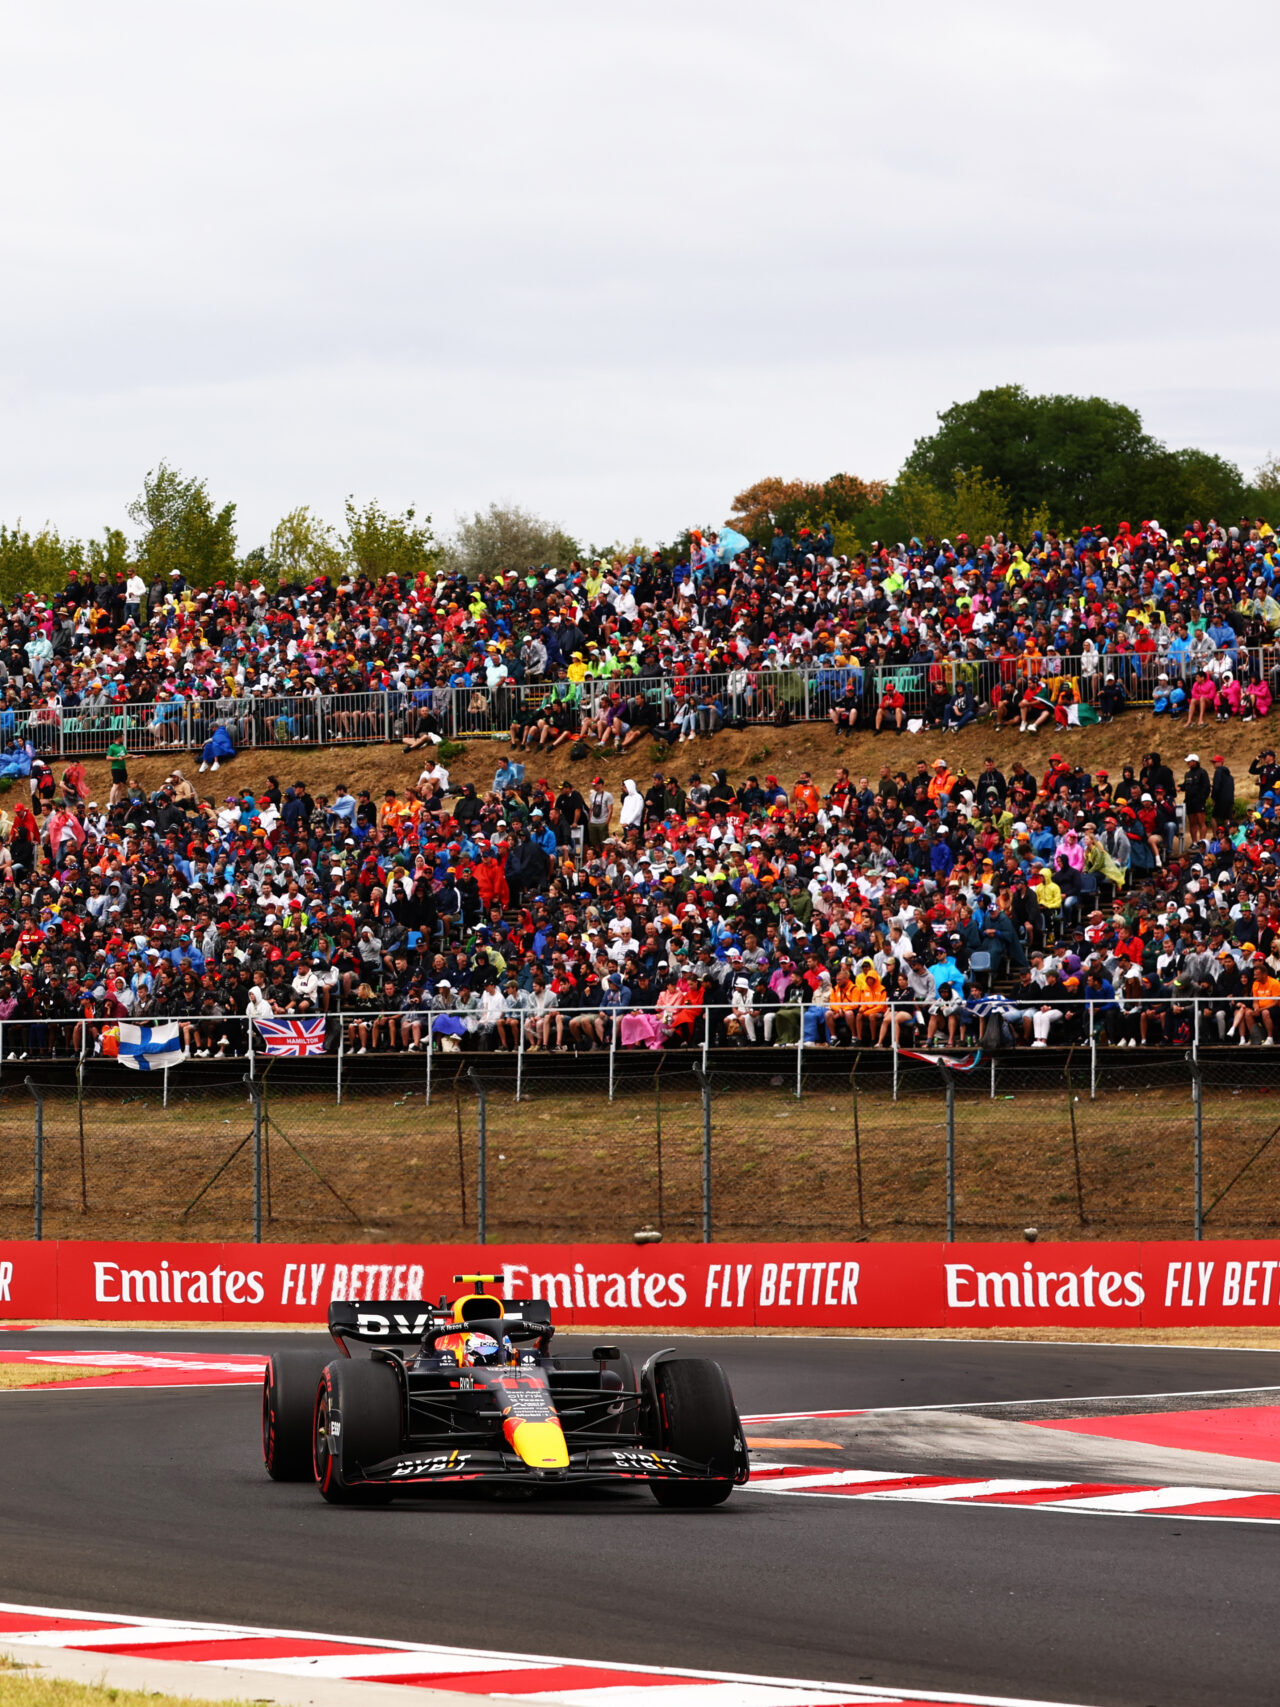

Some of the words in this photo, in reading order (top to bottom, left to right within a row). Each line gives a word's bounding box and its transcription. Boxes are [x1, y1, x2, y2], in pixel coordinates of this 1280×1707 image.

[94, 1260, 265, 1304] Emirates
[281, 1263, 326, 1305] FLY
[330, 1264, 425, 1301] BETTER
[502, 1263, 687, 1308] Emirates
[705, 1263, 753, 1308] FLY
[760, 1261, 860, 1306] BETTER
[944, 1261, 1146, 1308] Emirates
[1165, 1261, 1215, 1307] FLY
[1222, 1260, 1280, 1306] BET
[490, 1377, 546, 1389] 11
